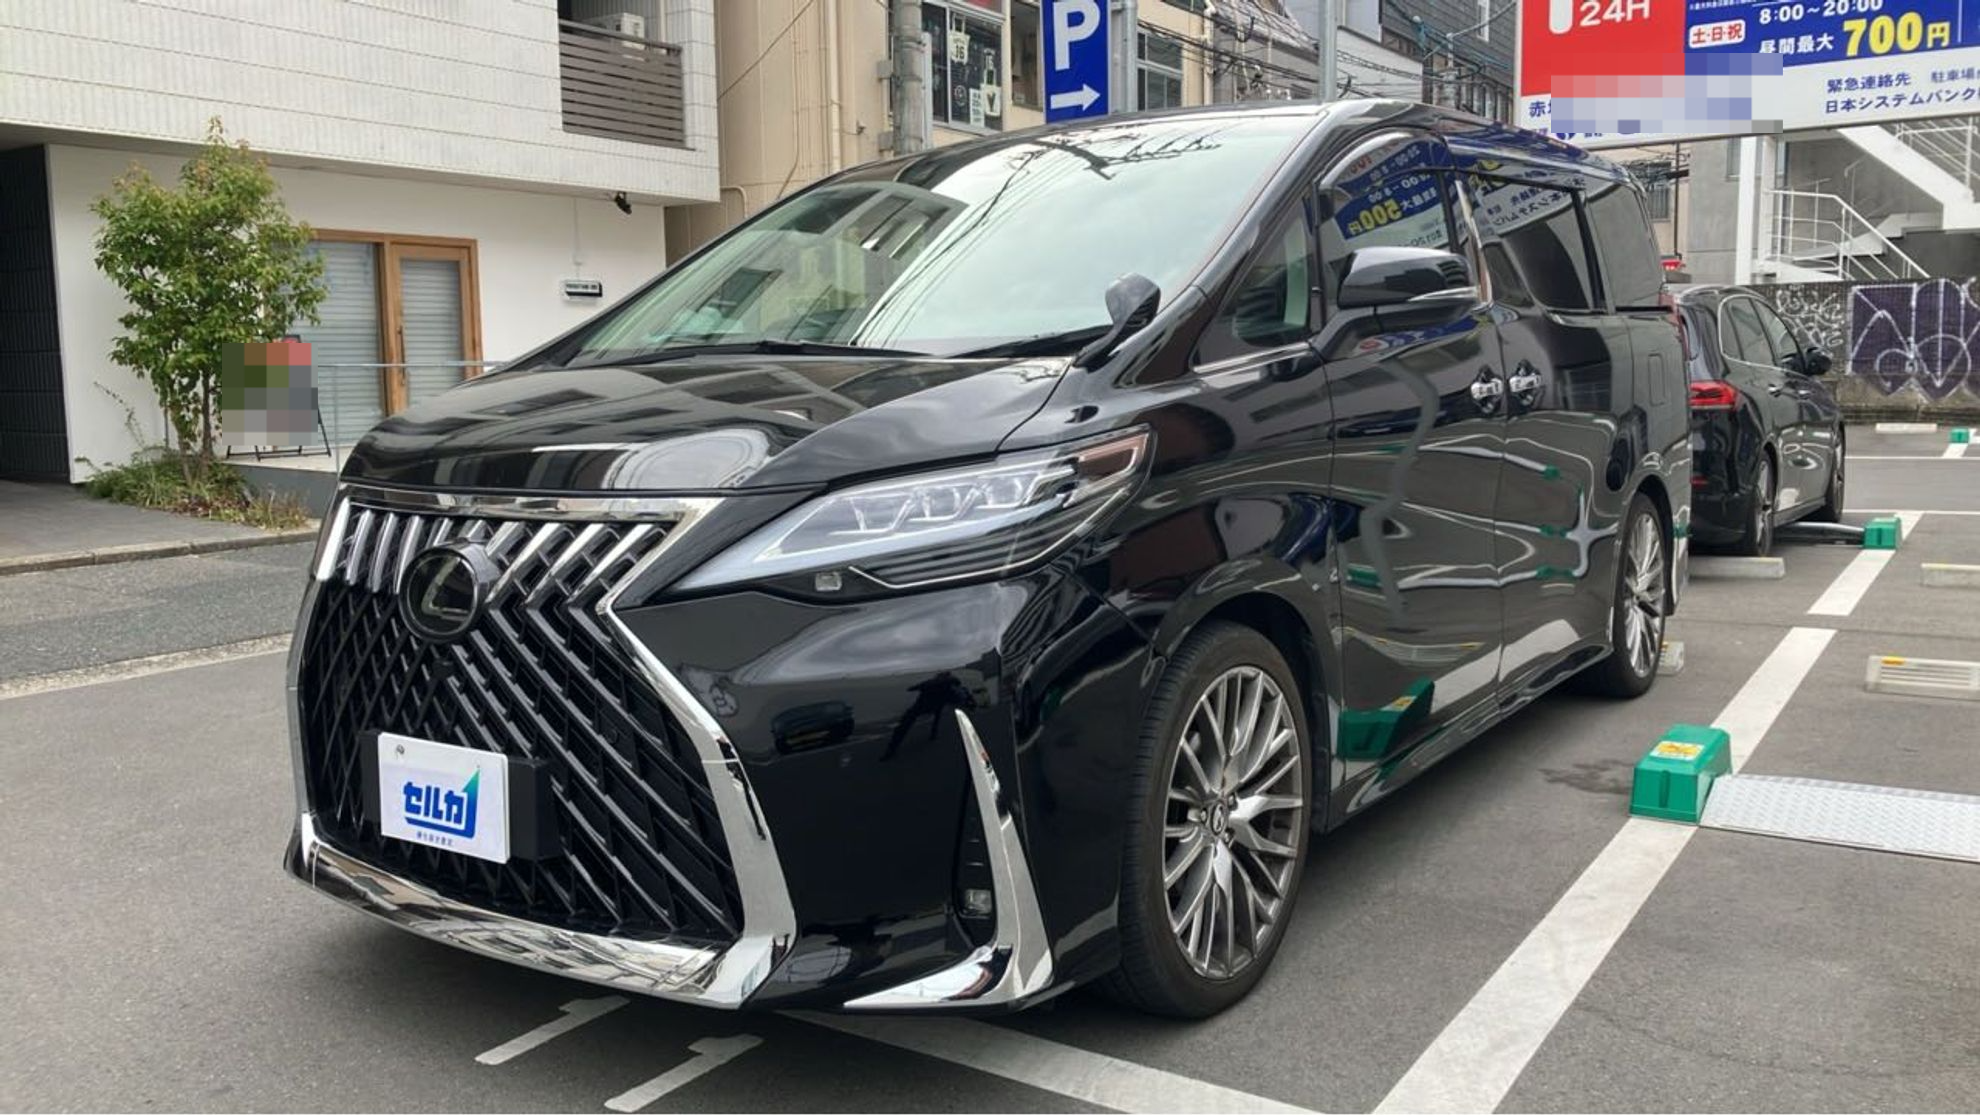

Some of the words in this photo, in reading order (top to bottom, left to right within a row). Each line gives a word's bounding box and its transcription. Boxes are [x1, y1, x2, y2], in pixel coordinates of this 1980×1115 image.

[1580, 0, 1650, 26] 24H
[1053, 1, 1101, 71] P
[1843, 11, 1951, 57] 700円
[1827, 72, 1911, 93] 緊急連絡先
[1826, 87, 1980, 113] 日本システムバンク
